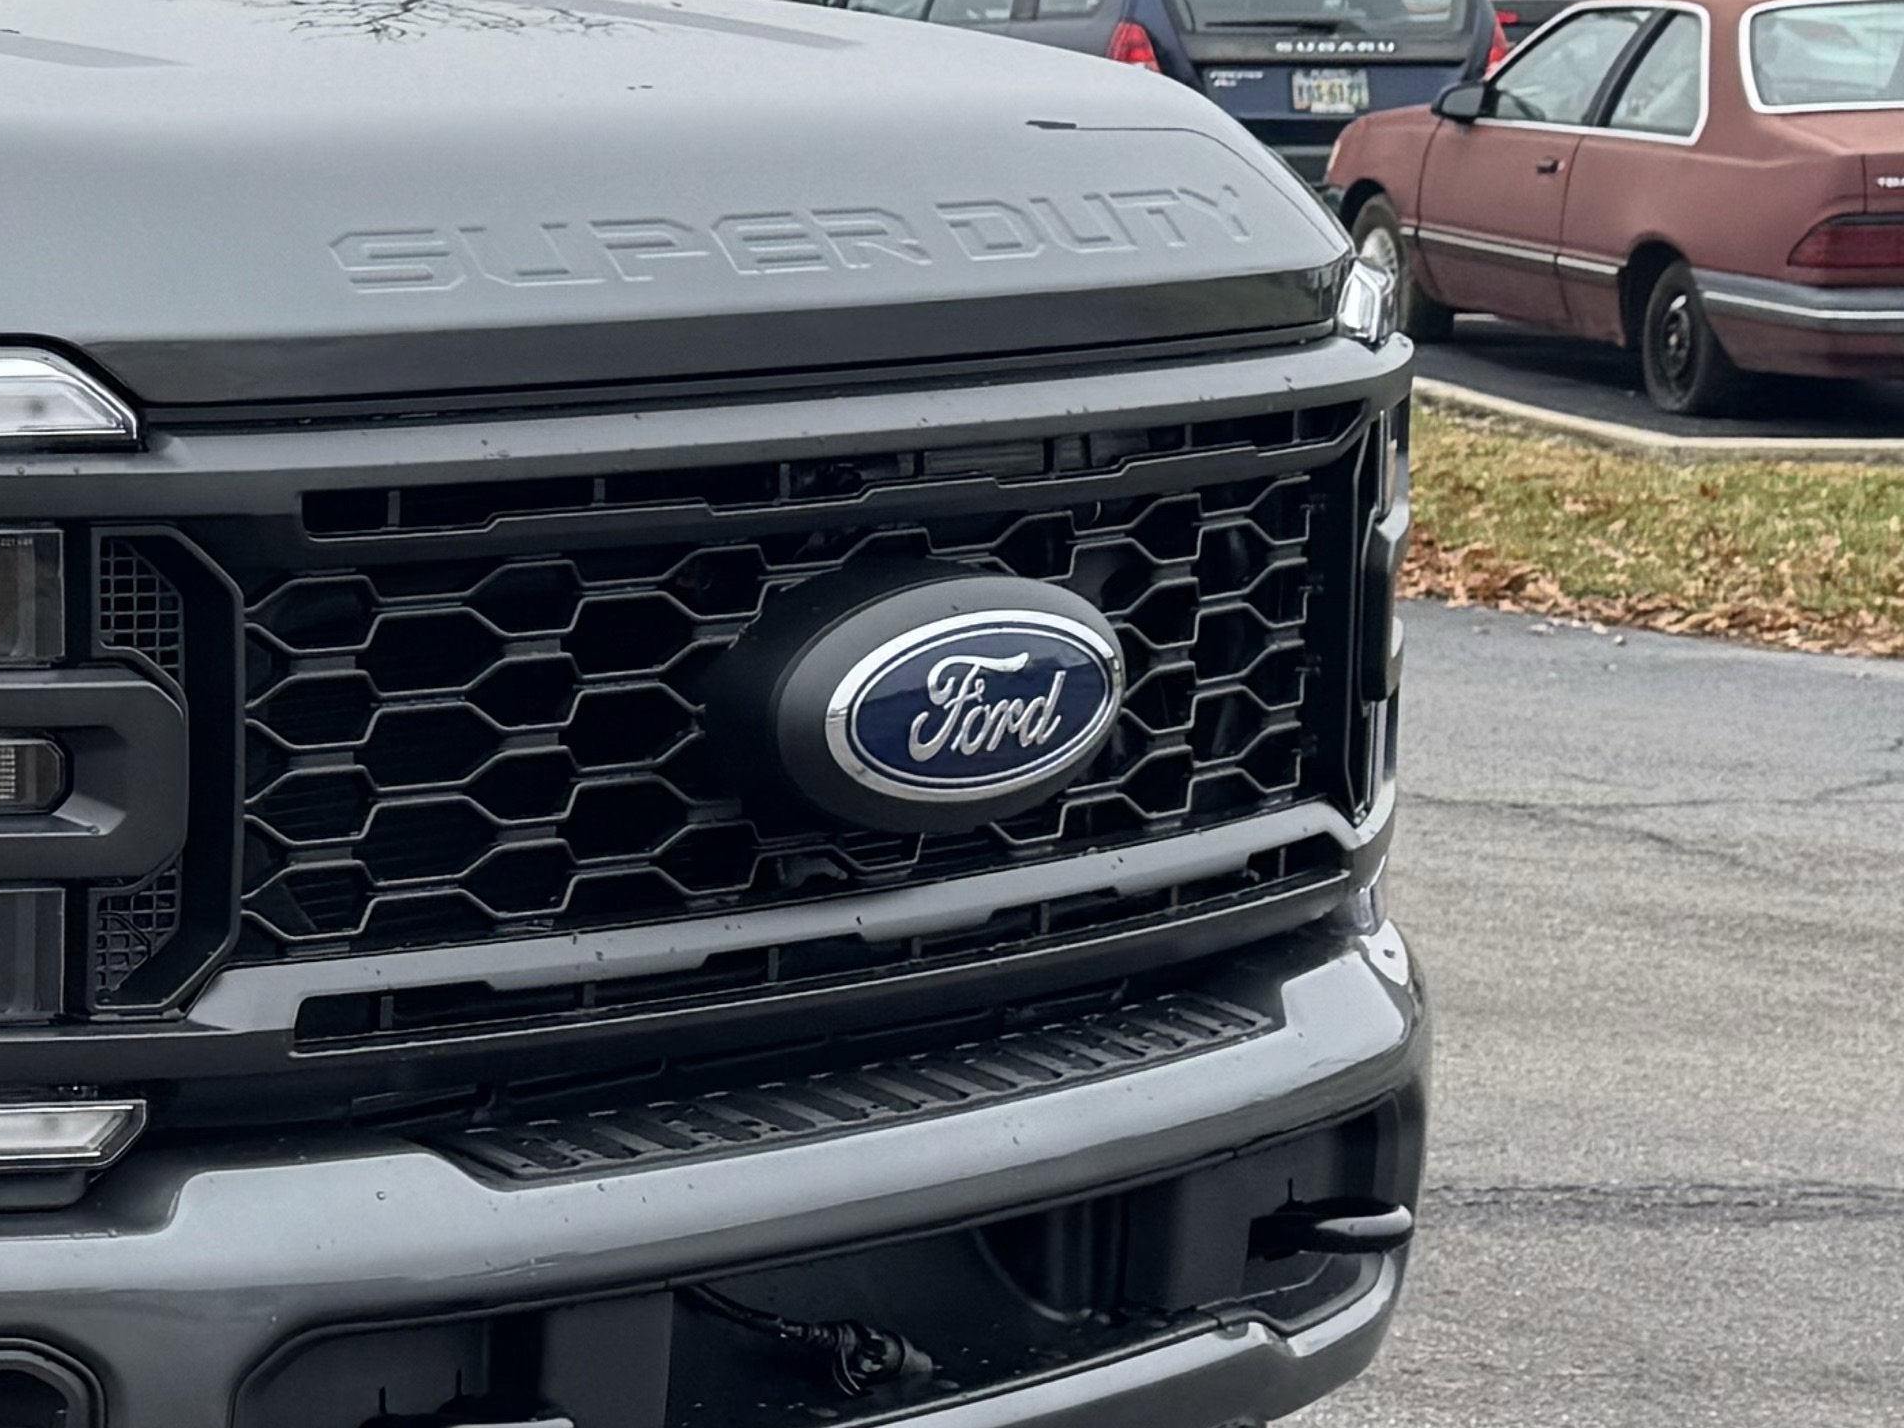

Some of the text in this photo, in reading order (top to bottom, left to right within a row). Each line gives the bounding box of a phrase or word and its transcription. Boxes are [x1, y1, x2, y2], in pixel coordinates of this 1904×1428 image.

[1275, 41, 1396, 54] SUBARU
[329, 184, 1253, 294] SUPER DUTY
[909, 651, 1066, 762] Ford
